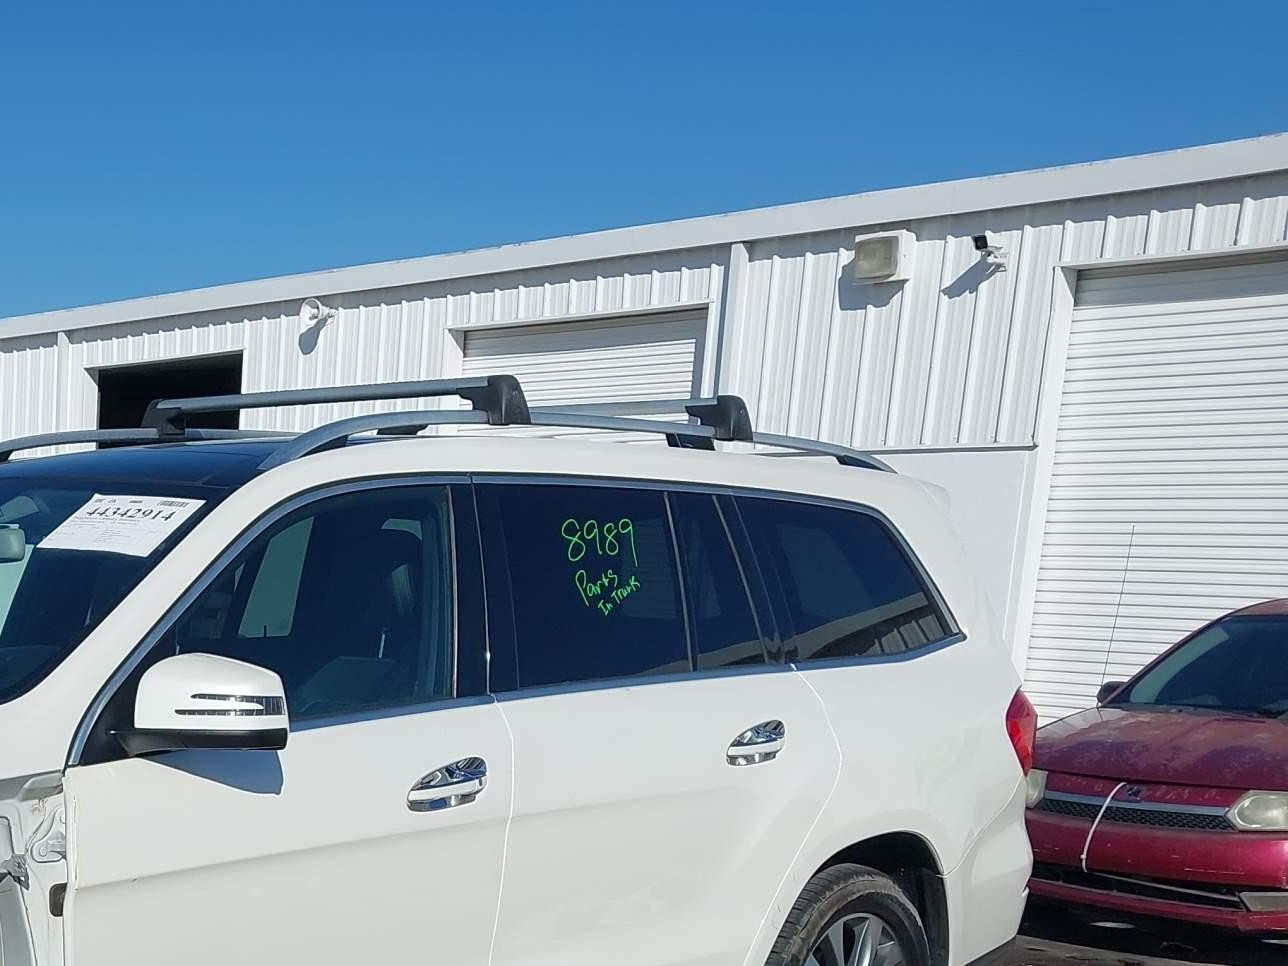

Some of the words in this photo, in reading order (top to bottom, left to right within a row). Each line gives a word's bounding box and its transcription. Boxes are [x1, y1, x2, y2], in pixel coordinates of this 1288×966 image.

[86, 506, 177, 521] 44342914
[561, 518, 638, 568] 8989
[575, 569, 618, 607] Parts
[597, 599, 614, 616] In
